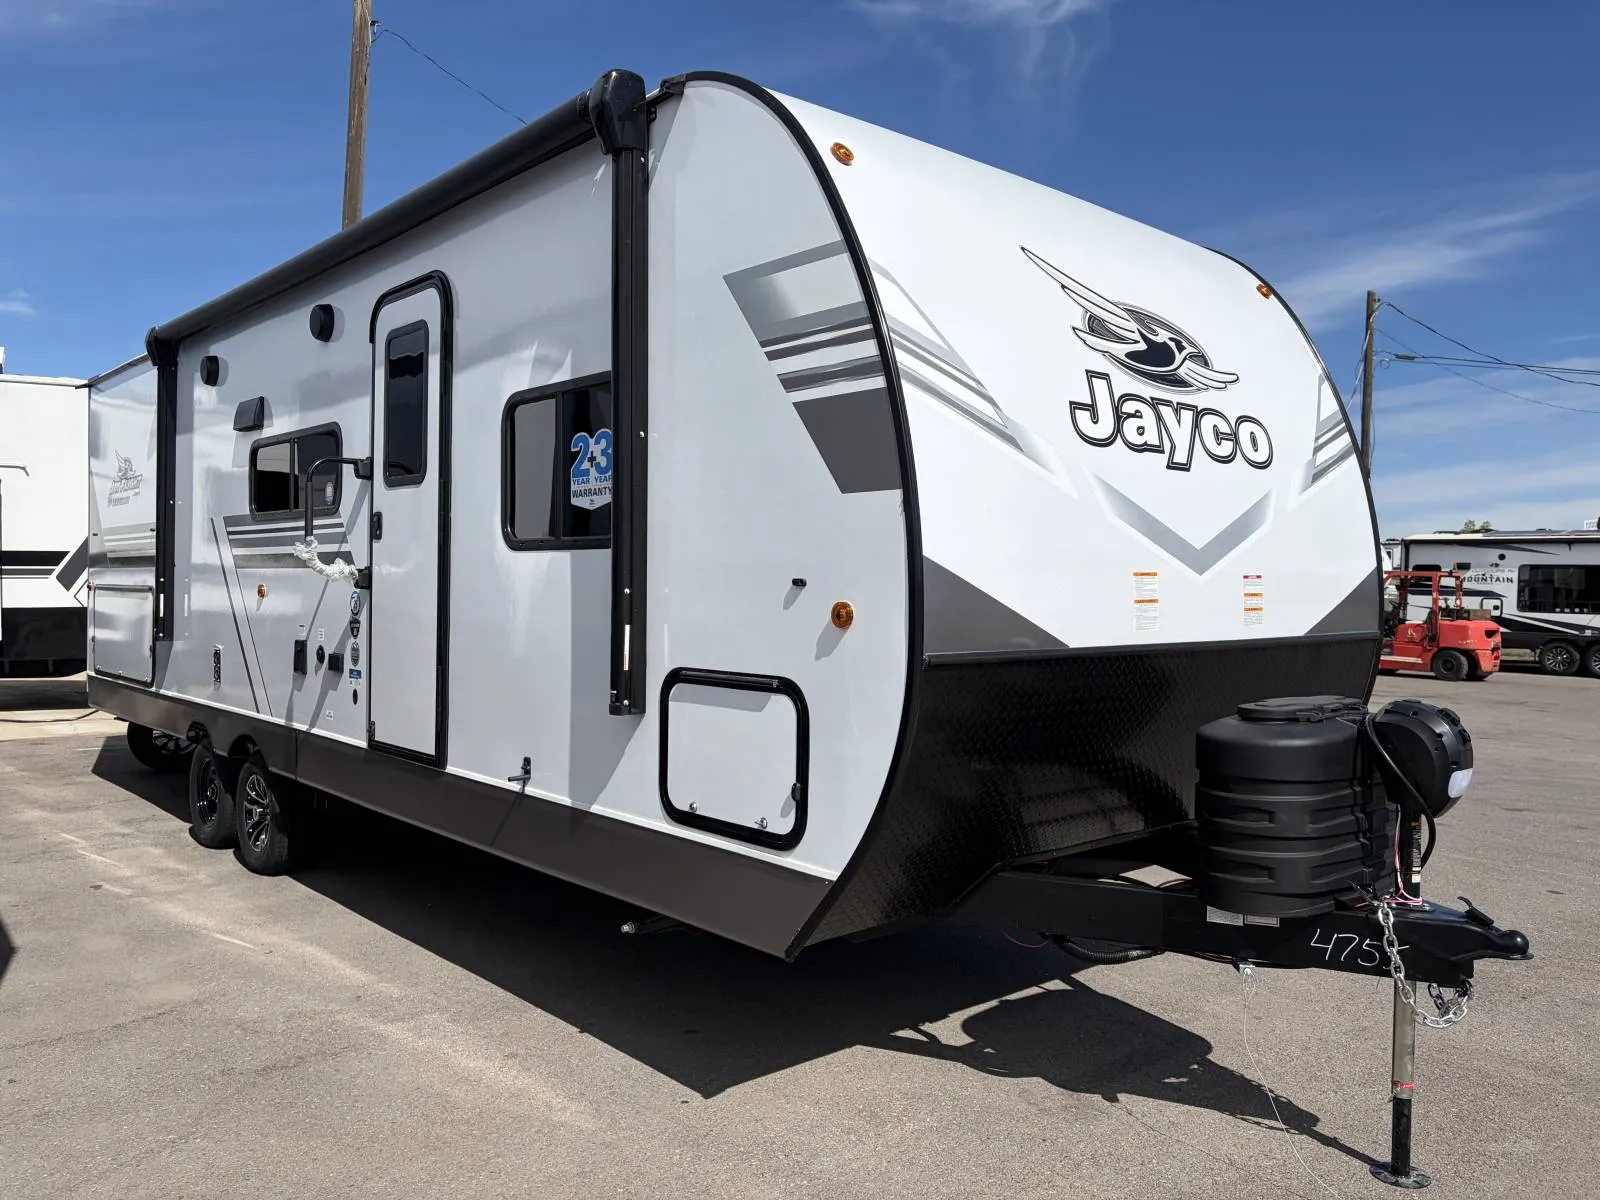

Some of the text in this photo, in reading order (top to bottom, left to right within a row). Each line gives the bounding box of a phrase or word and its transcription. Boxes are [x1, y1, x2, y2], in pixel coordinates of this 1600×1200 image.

[1069, 369, 1273, 472] Jayco
[572, 478, 590, 486] YEAR
[572, 487, 612, 498] WARRANTY
